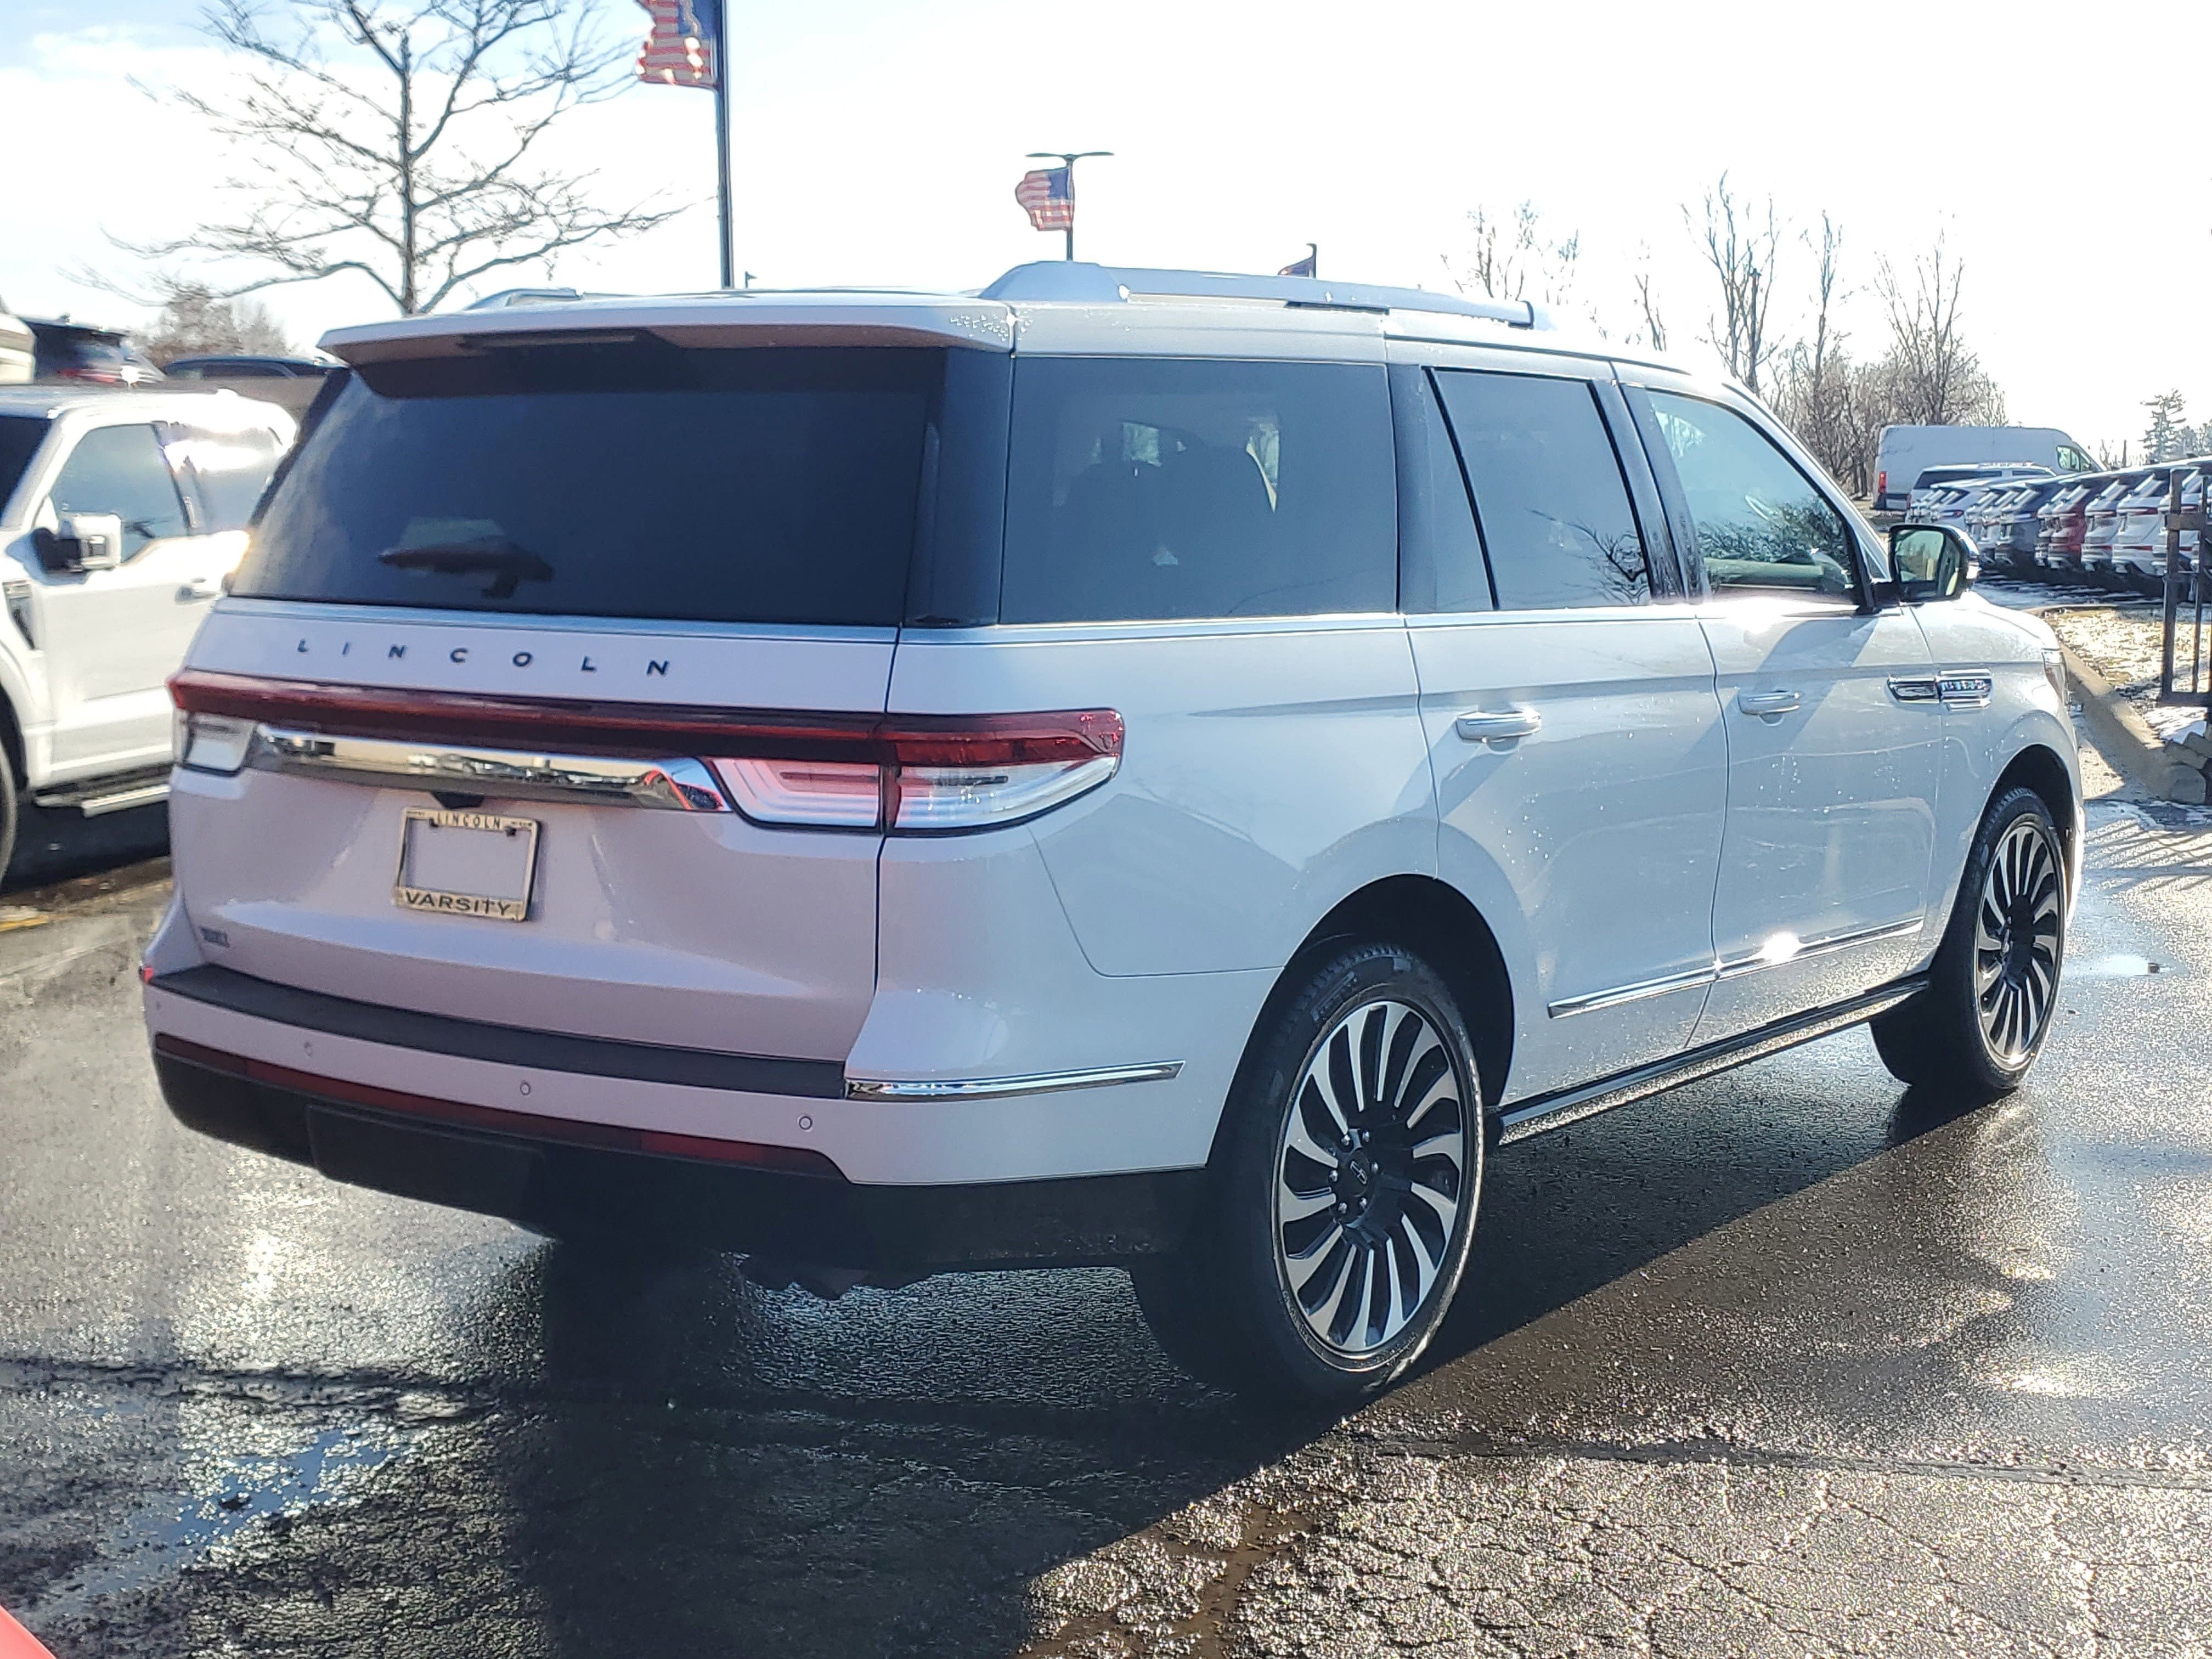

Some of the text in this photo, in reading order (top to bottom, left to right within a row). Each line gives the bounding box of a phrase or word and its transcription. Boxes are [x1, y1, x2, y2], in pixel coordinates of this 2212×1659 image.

[297, 639, 670, 676] LINCOLN
[438, 812, 501, 829] LINCOLN
[405, 891, 511, 916] VARSITY
